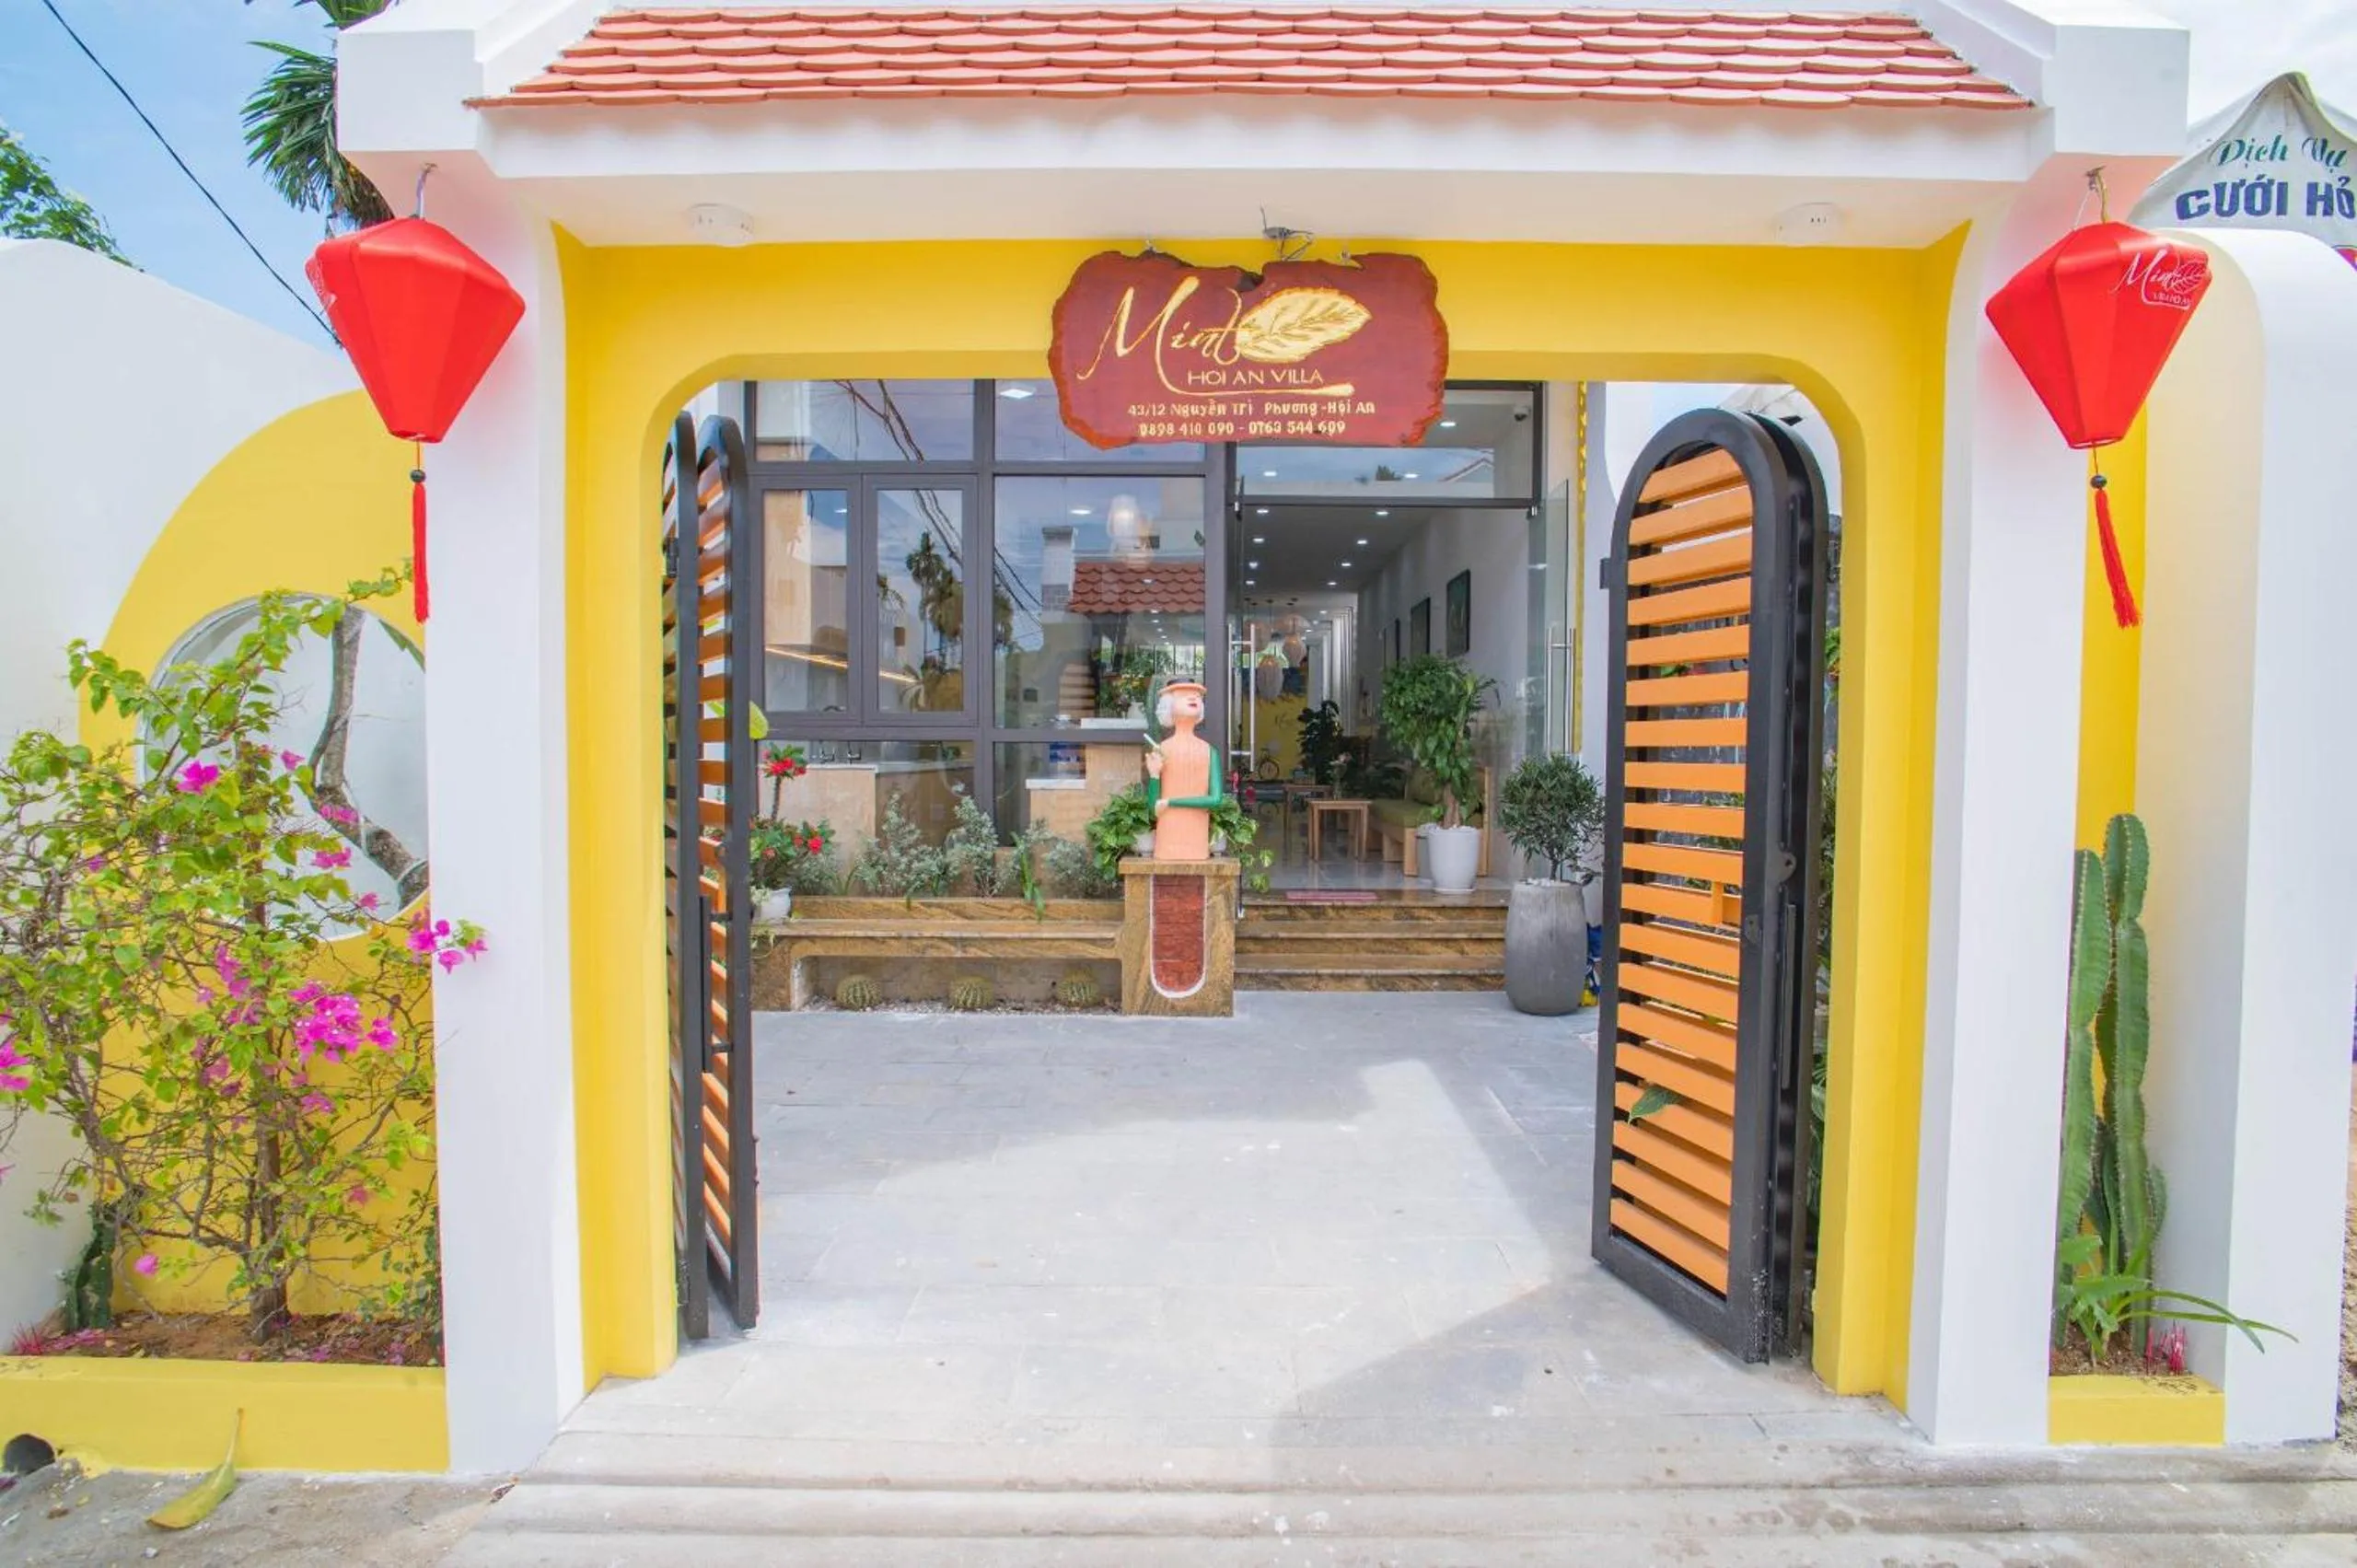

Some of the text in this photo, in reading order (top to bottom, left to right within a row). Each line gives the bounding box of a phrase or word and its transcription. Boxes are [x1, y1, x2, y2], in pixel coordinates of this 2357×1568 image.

[2210, 134, 2347, 173] Dịch Vụ
[2176, 173, 2289, 220] CƯỚI
[1075, 275, 1254, 396] Mint
[1232, 370, 1264, 385] AN
[1271, 368, 1323, 384] VILLA
[1127, 402, 1166, 417] 43/12
[1356, 401, 1376, 414] An
[1138, 422, 1175, 437] 0898
[1178, 422, 1202, 436] 410
[1208, 421, 1234, 436] 090
[1248, 420, 1282, 436] 0763
[1287, 420, 1313, 436] 544
